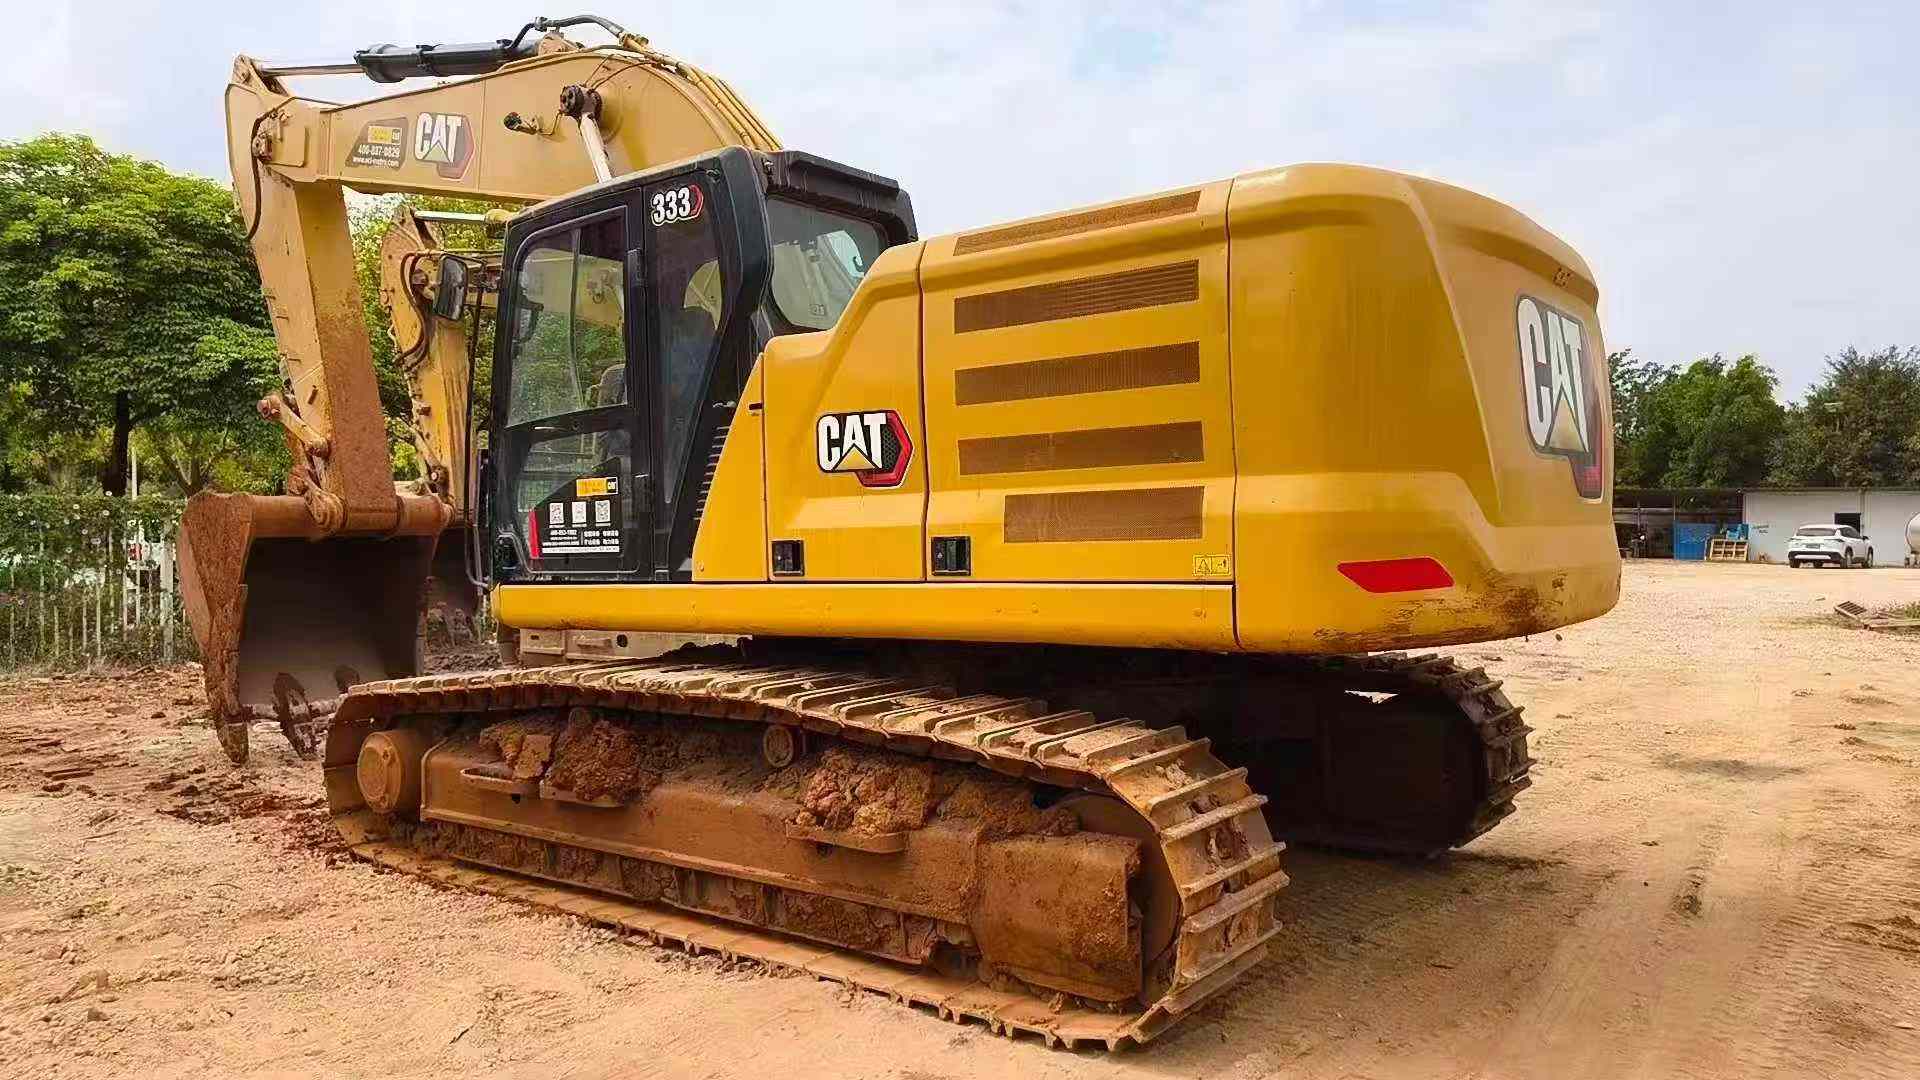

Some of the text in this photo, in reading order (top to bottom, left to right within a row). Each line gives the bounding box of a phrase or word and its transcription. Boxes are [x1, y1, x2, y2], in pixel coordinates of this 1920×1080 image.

[415, 112, 461, 163] CAT
[652, 187, 690, 222] 333
[1518, 298, 1590, 453] CAT
[818, 412, 887, 471] CAT
